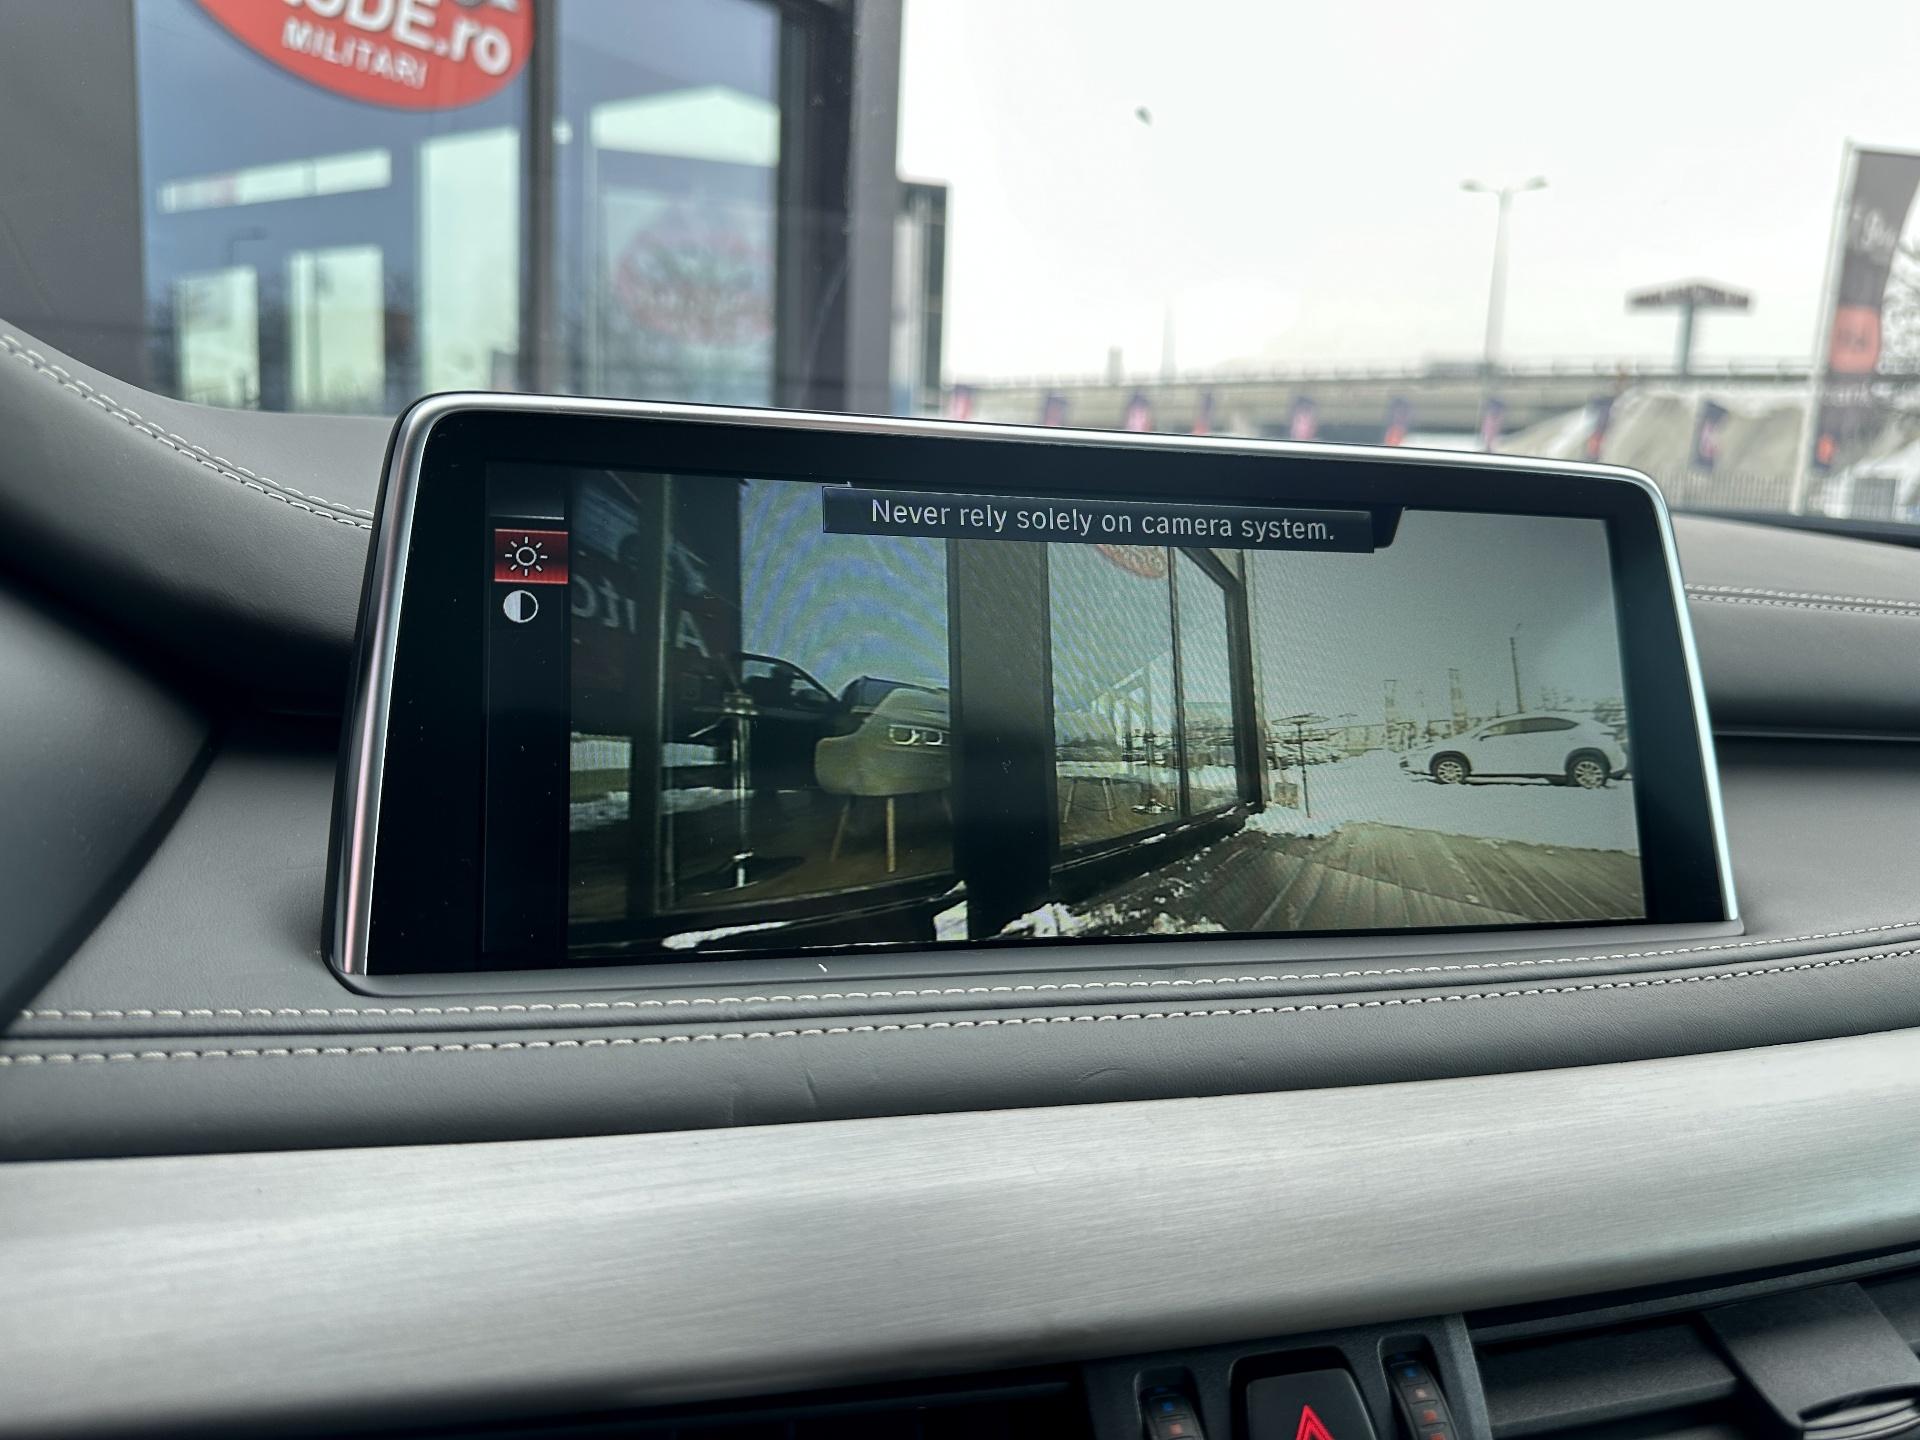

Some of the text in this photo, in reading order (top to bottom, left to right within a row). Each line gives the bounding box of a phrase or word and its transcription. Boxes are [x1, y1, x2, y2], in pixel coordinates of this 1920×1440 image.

[281, 16, 428, 90] MILITARI
[872, 499, 1334, 543] Never rely solely on camera system.
